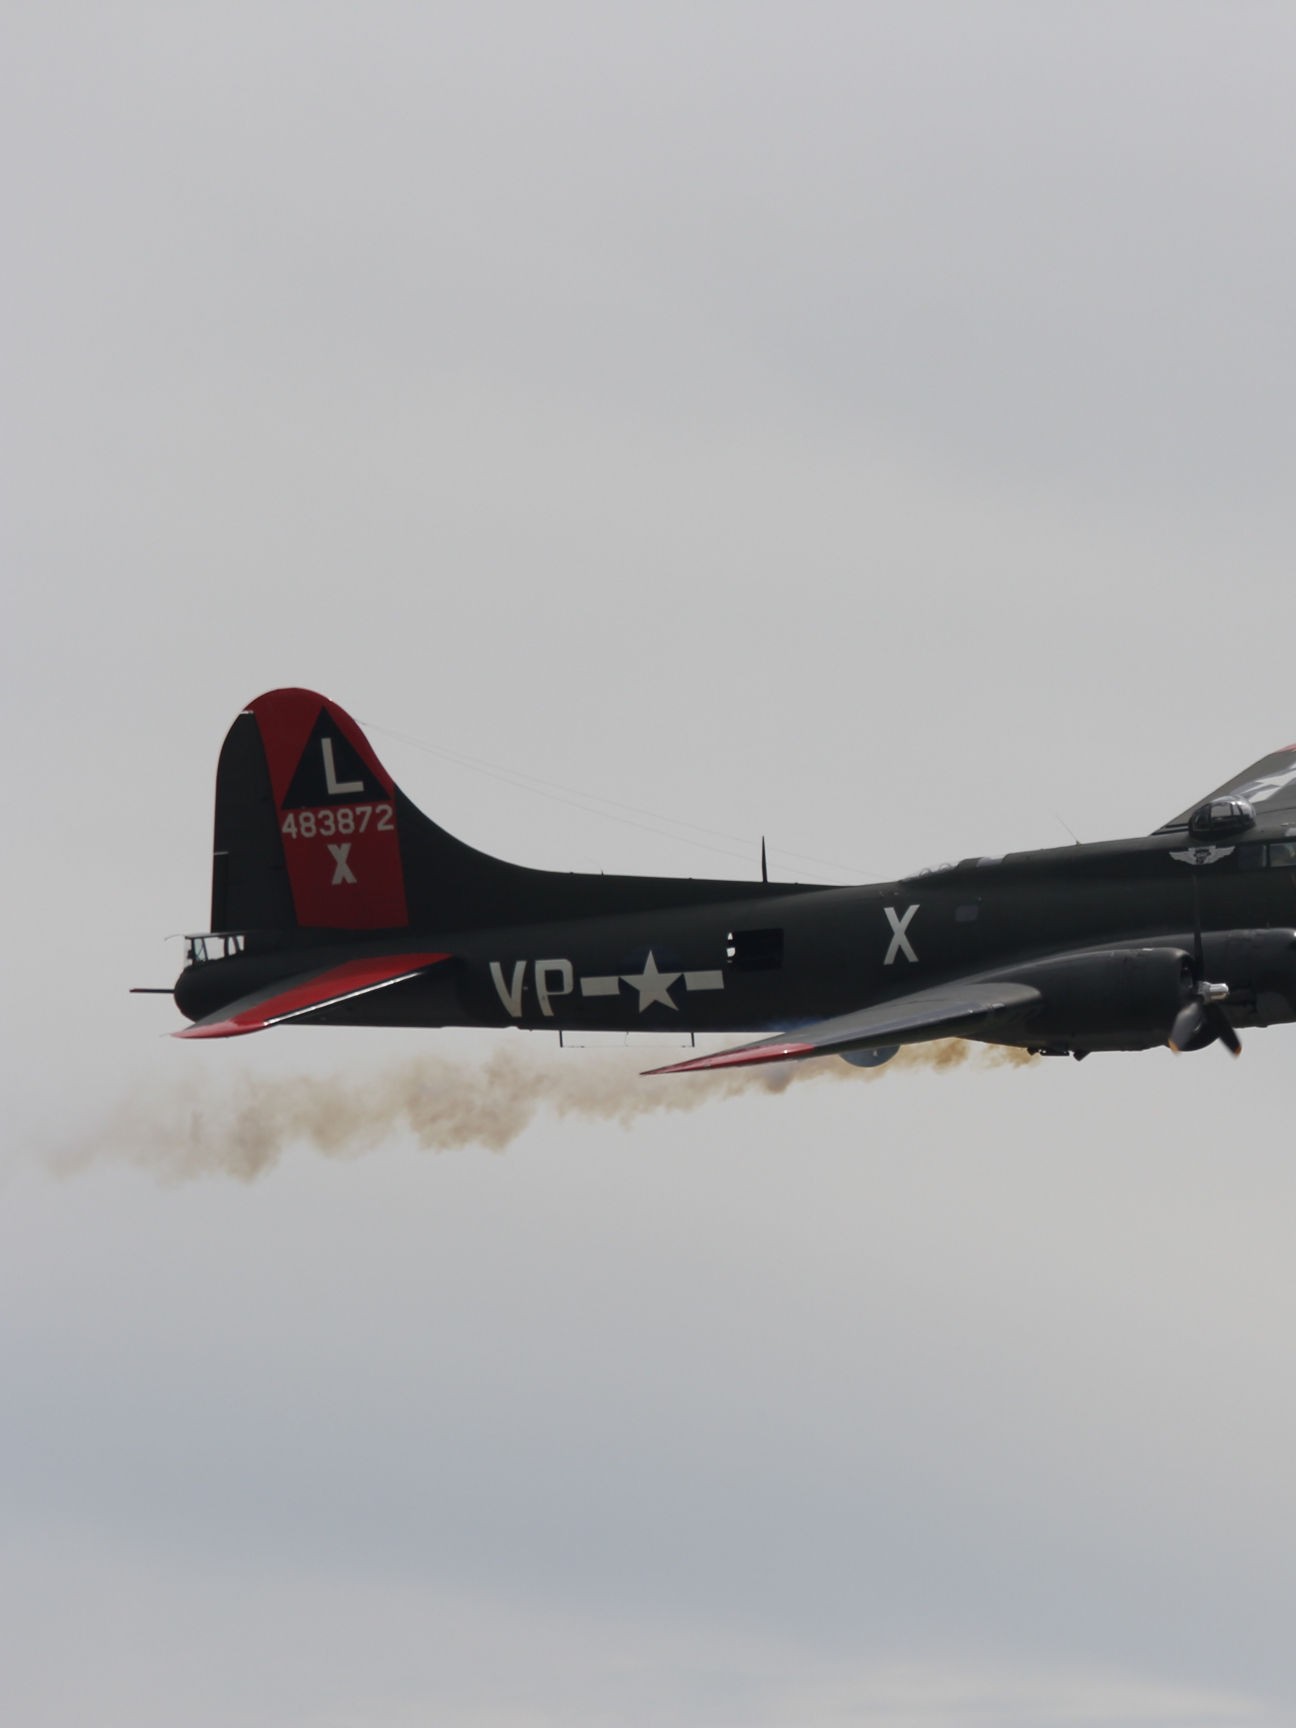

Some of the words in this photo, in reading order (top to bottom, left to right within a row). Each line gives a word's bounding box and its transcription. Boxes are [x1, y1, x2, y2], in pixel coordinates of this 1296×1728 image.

[321, 737, 364, 795] L
[282, 805, 394, 839] 483872
[327, 843, 357, 885] X
[883, 904, 920, 965] X
[490, 959, 573, 1017] VP
